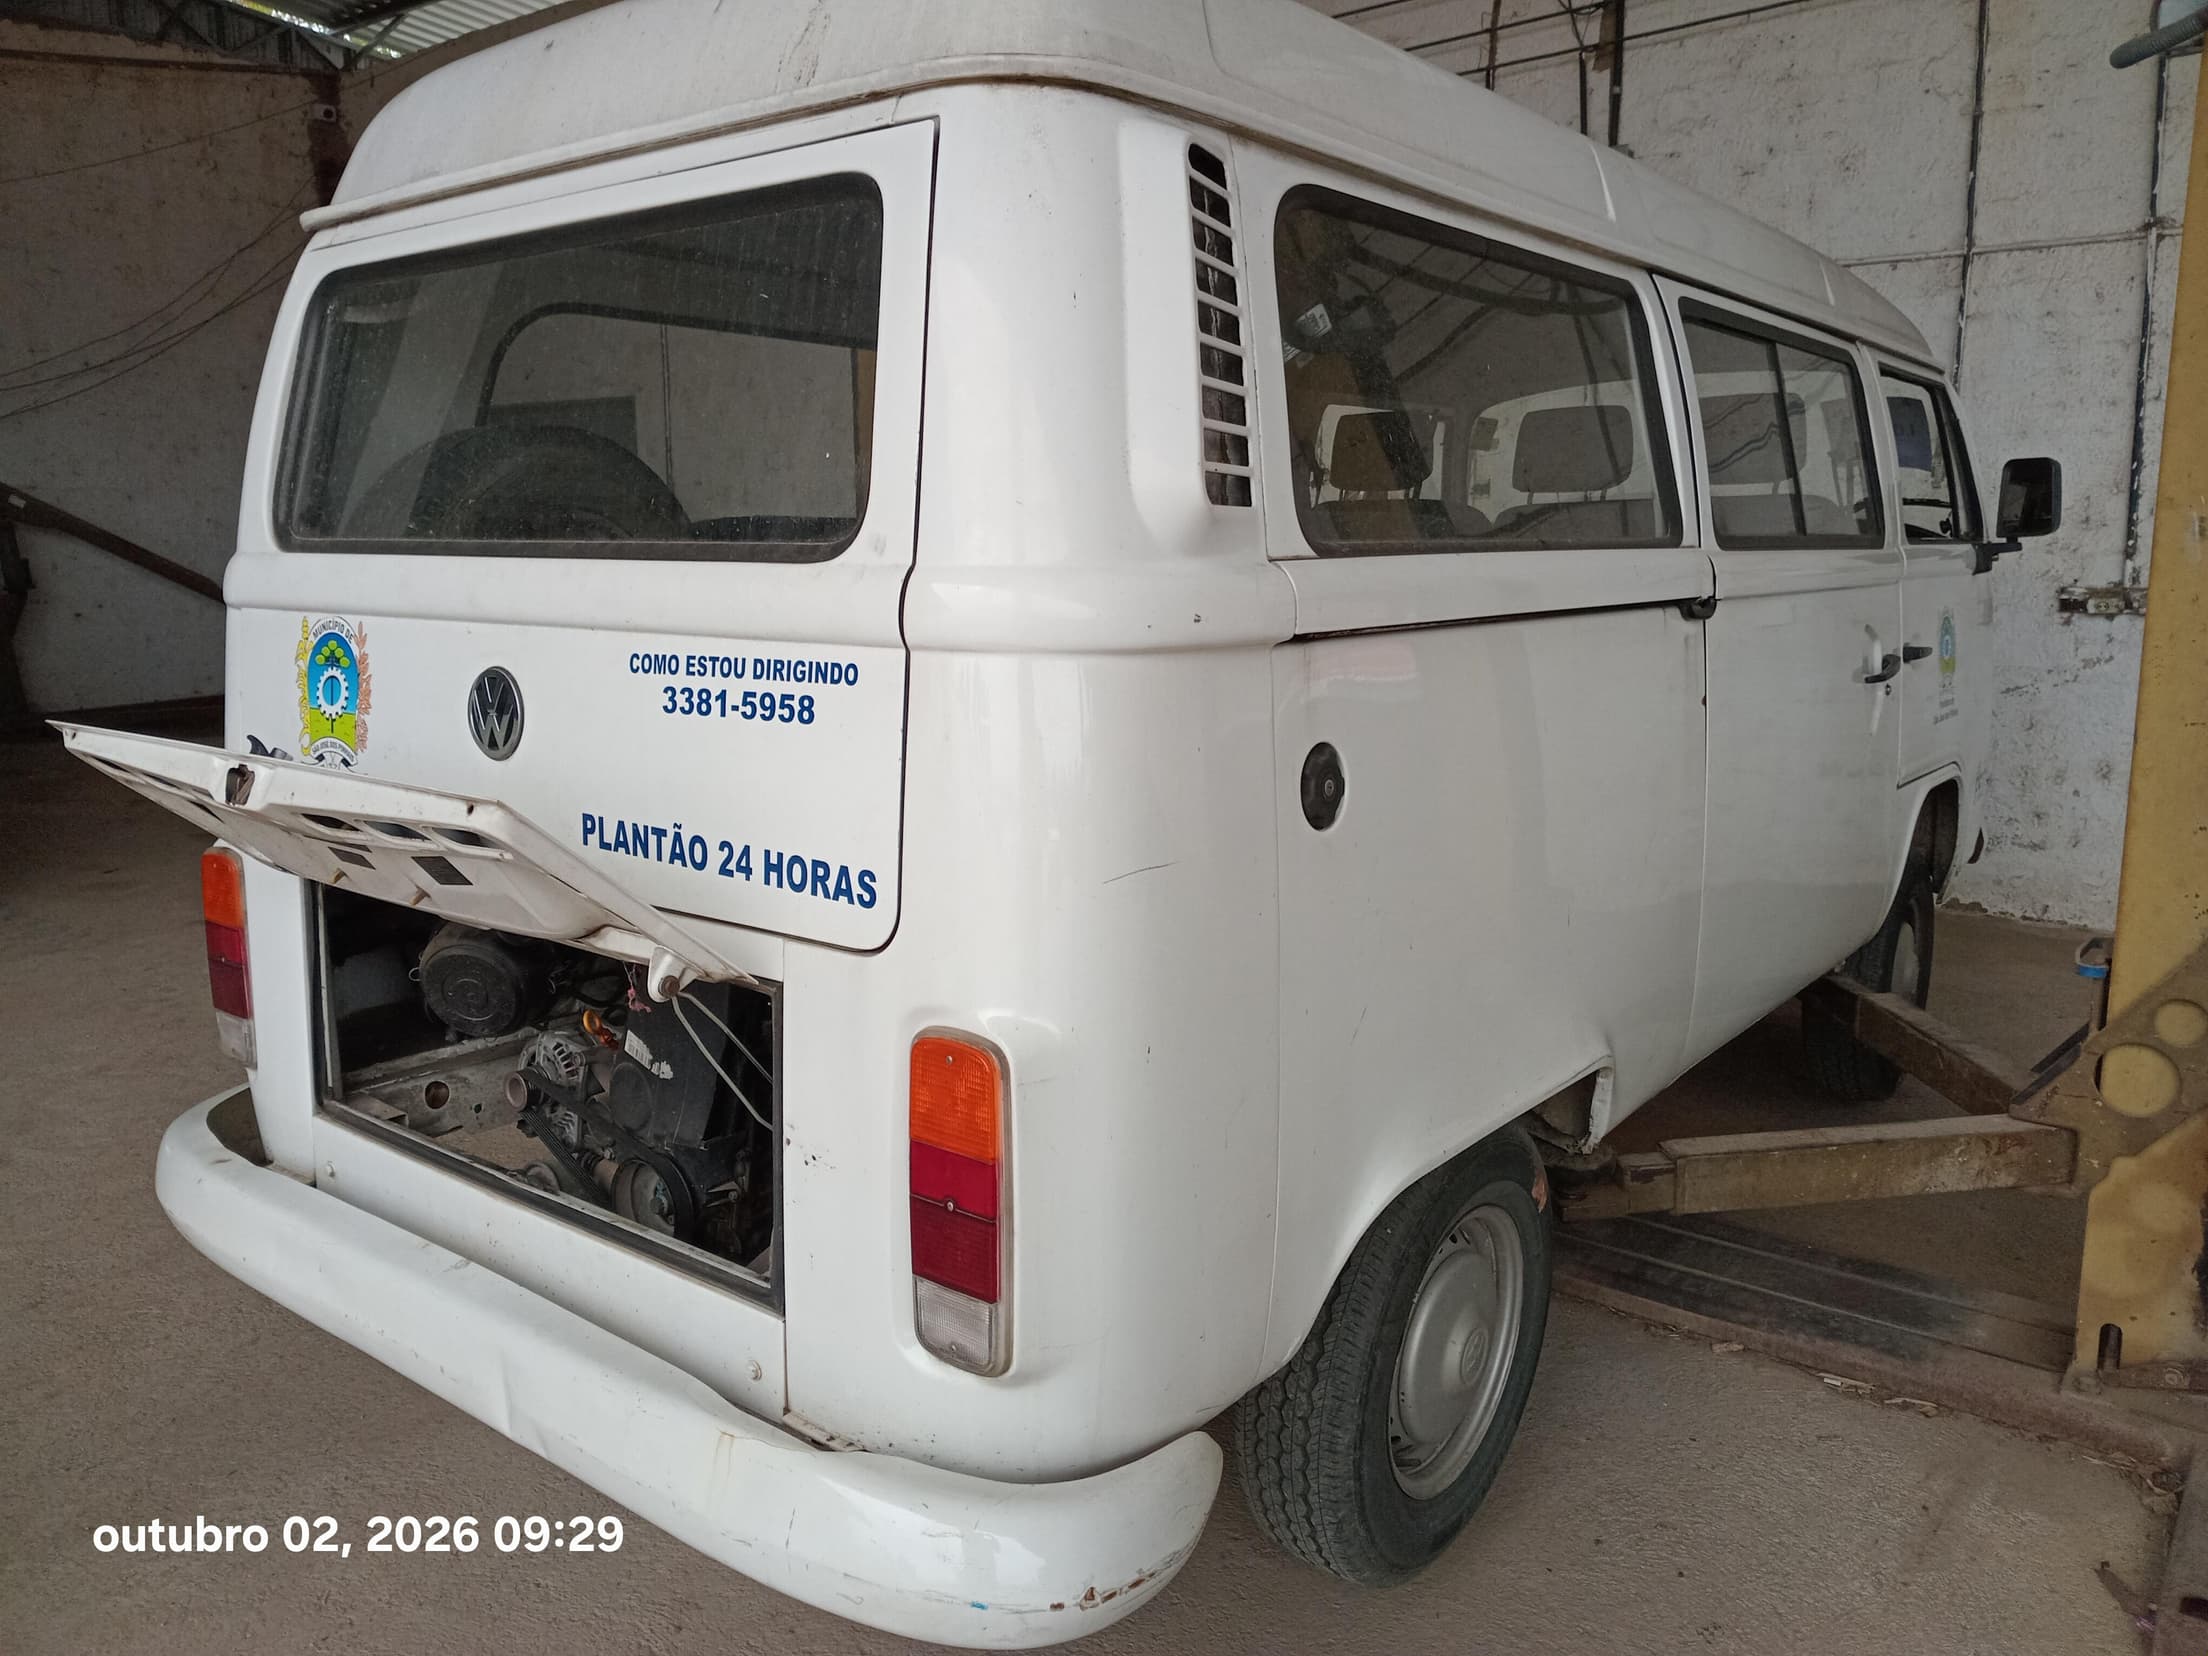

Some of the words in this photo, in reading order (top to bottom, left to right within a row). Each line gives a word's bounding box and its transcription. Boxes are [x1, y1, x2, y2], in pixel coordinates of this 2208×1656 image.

[345, 628, 354, 644] DE
[629, 652, 680, 676] COMO
[685, 654, 747, 680] ESTOU
[752, 657, 859, 687] DIRIGINDO
[471, 670, 520, 756] VW
[662, 685, 815, 725] 3381-5958
[581, 812, 709, 872] PLANTÃO
[718, 839, 753, 881] 24
[763, 848, 877, 911] HORAS
